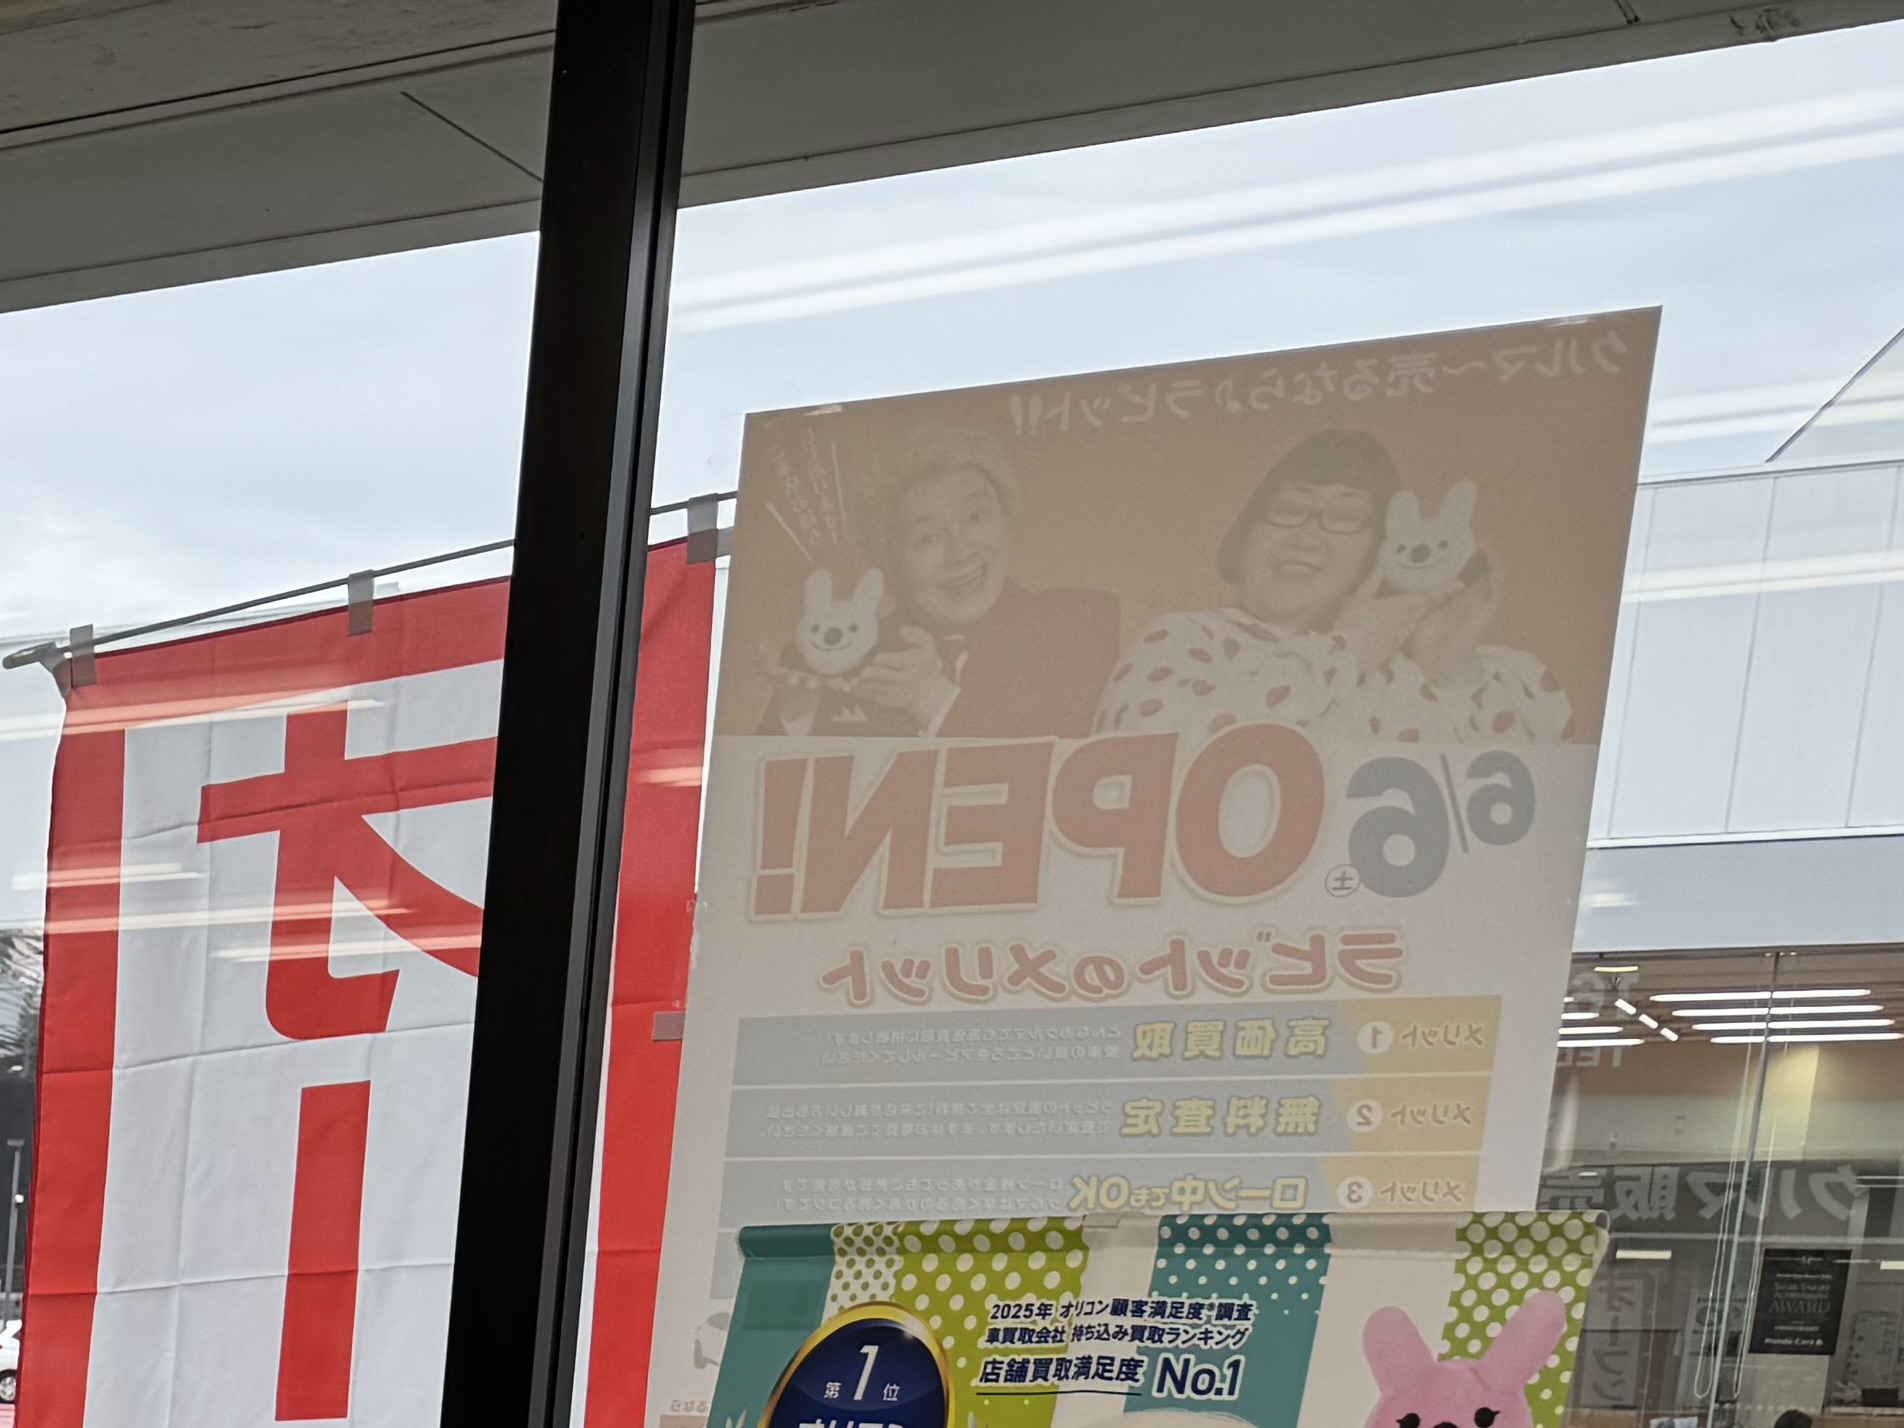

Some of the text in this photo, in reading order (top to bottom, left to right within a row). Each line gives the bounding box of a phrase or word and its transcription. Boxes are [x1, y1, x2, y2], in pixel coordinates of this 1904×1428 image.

[990, 1302, 1053, 1321] 2025年
[984, 1323, 1250, 1348] 車買取会社 持ち込み買取ランキング
[979, 1355, 1243, 1397] 店舗買取満足度 No.1
